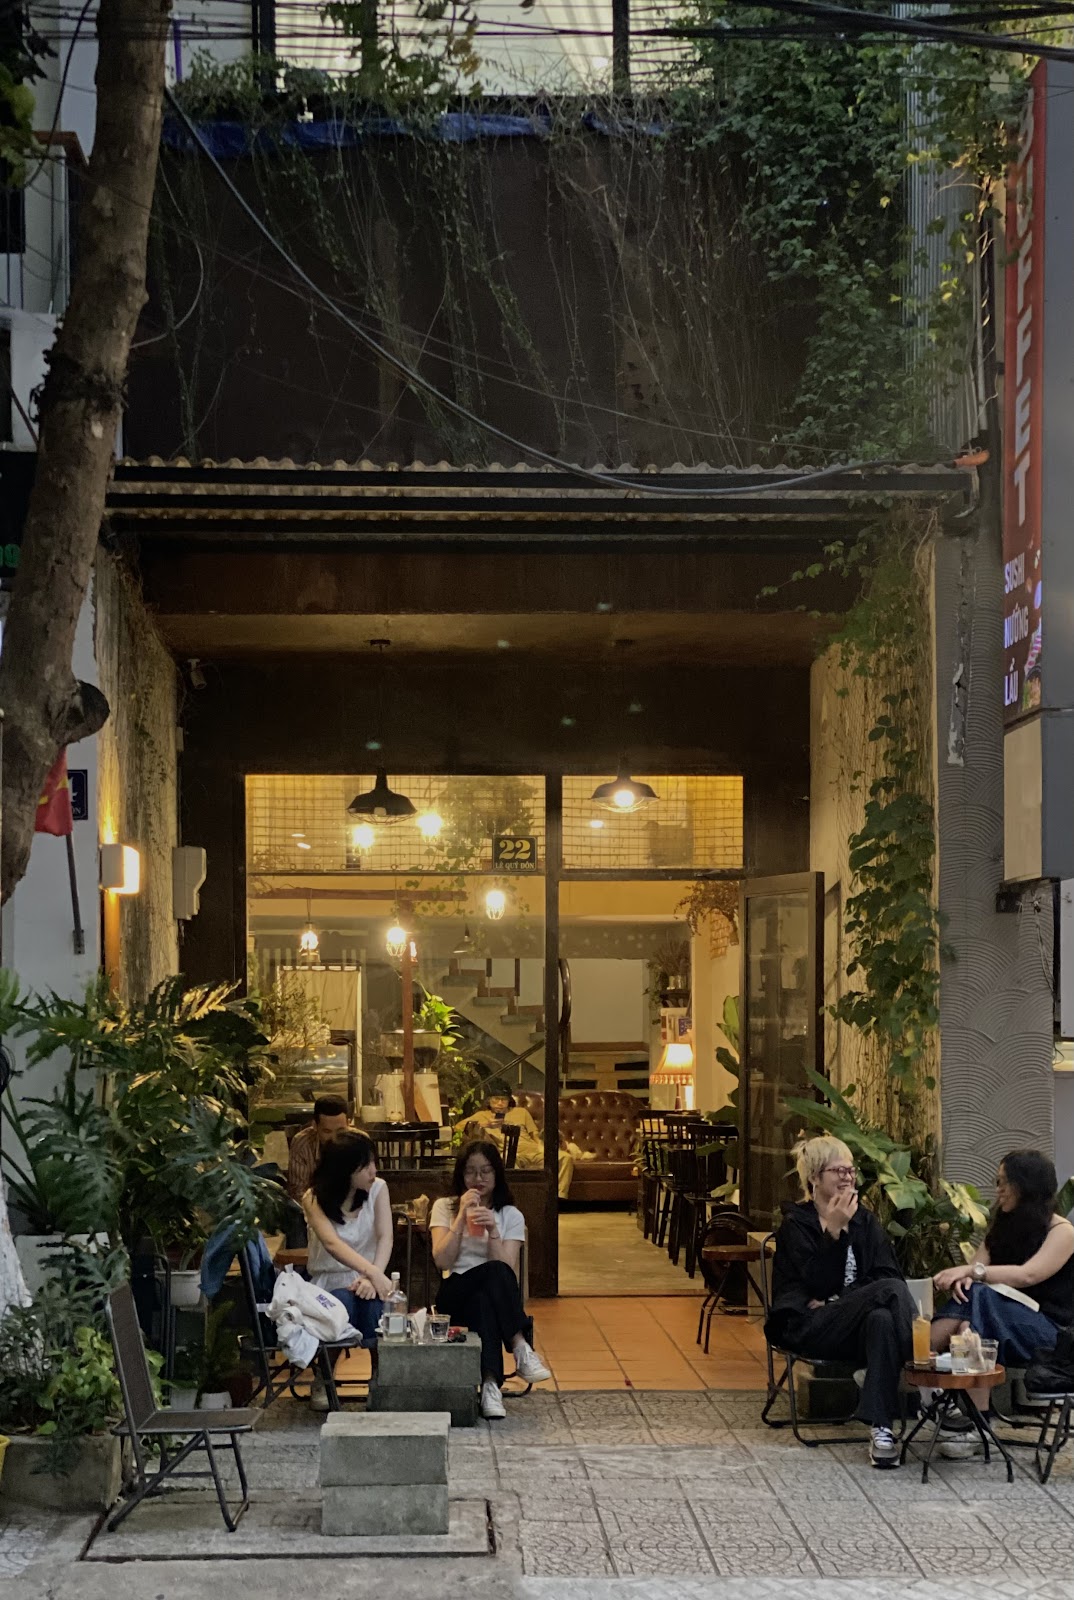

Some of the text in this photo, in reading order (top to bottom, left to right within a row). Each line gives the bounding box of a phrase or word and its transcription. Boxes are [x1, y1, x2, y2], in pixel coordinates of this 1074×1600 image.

[1015, 86, 1034, 527] BUFFET
[1004, 553, 1025, 594] SUSHI
[1004, 603, 1028, 648] NƯỚNG
[499, 840, 531, 860] 22
